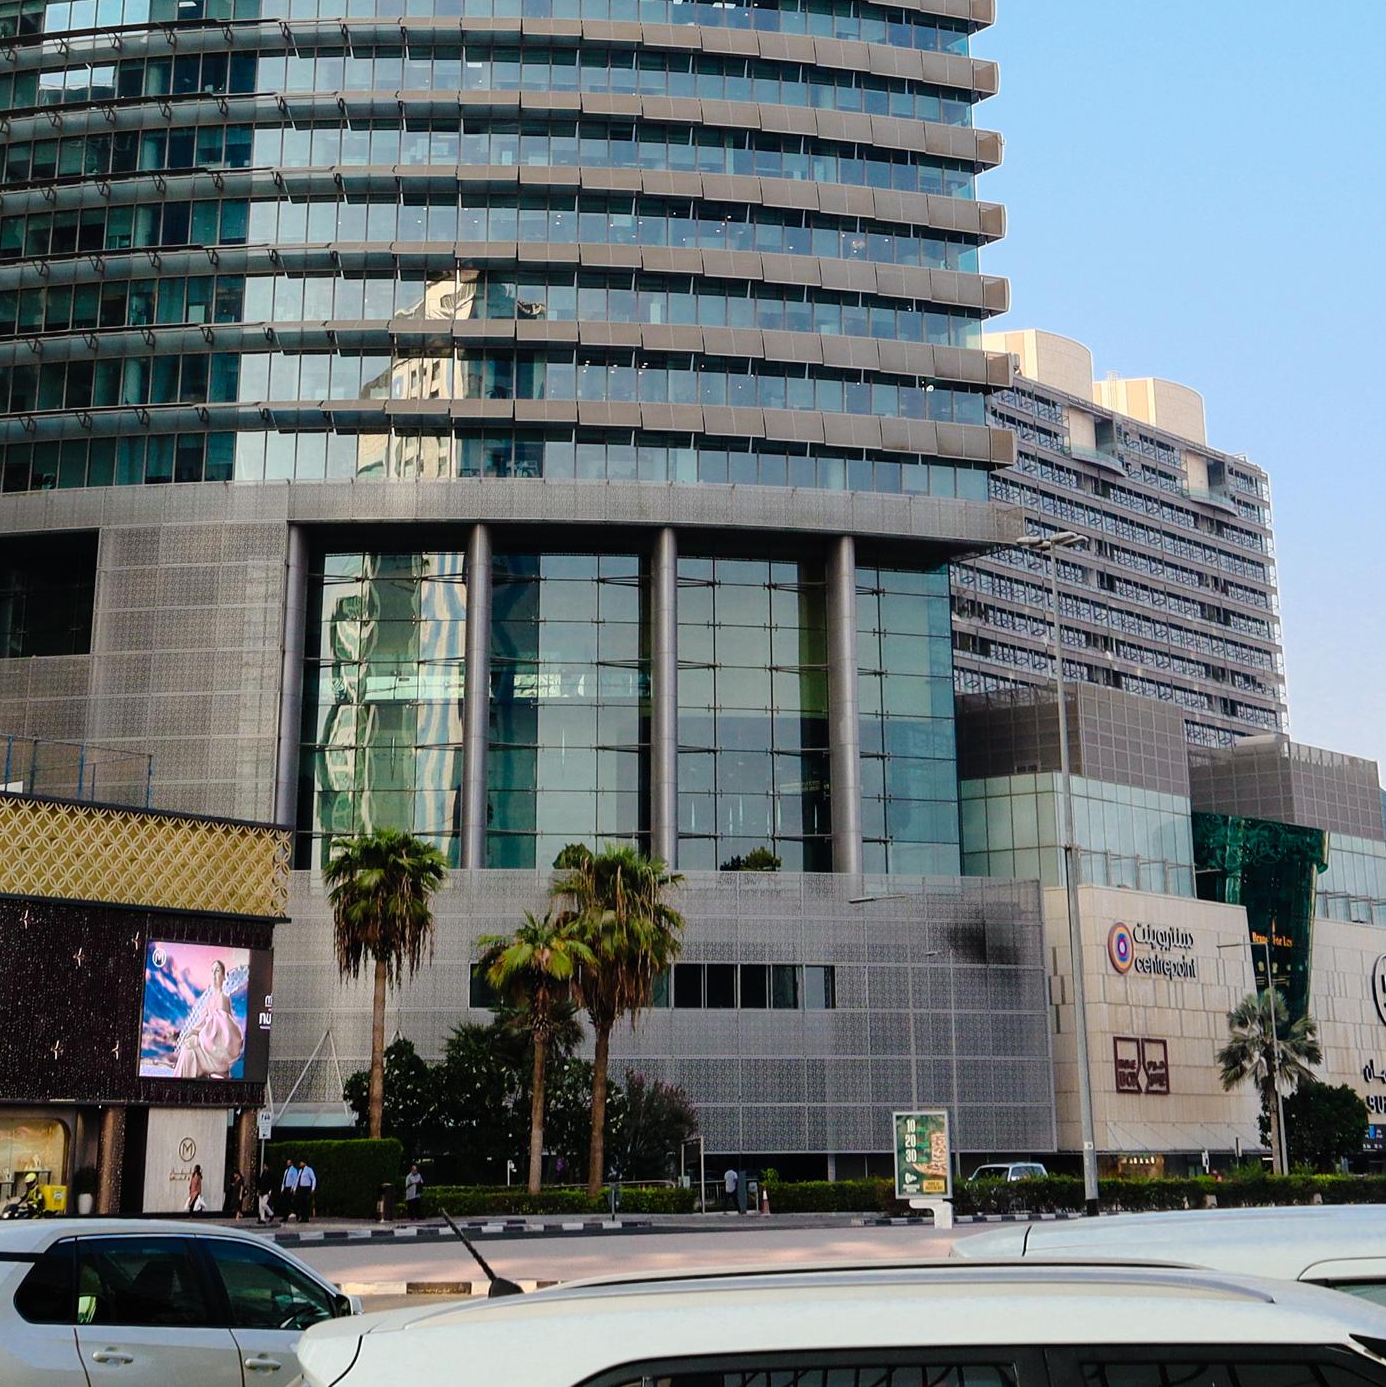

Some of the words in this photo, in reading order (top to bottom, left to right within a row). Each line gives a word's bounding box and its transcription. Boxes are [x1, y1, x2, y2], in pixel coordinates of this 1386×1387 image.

[1134, 955, 1197, 980] centrepoint
[906, 1119, 916, 1133] 10
[905, 1134, 917, 1148] 20
[905, 1149, 917, 1163] 30
